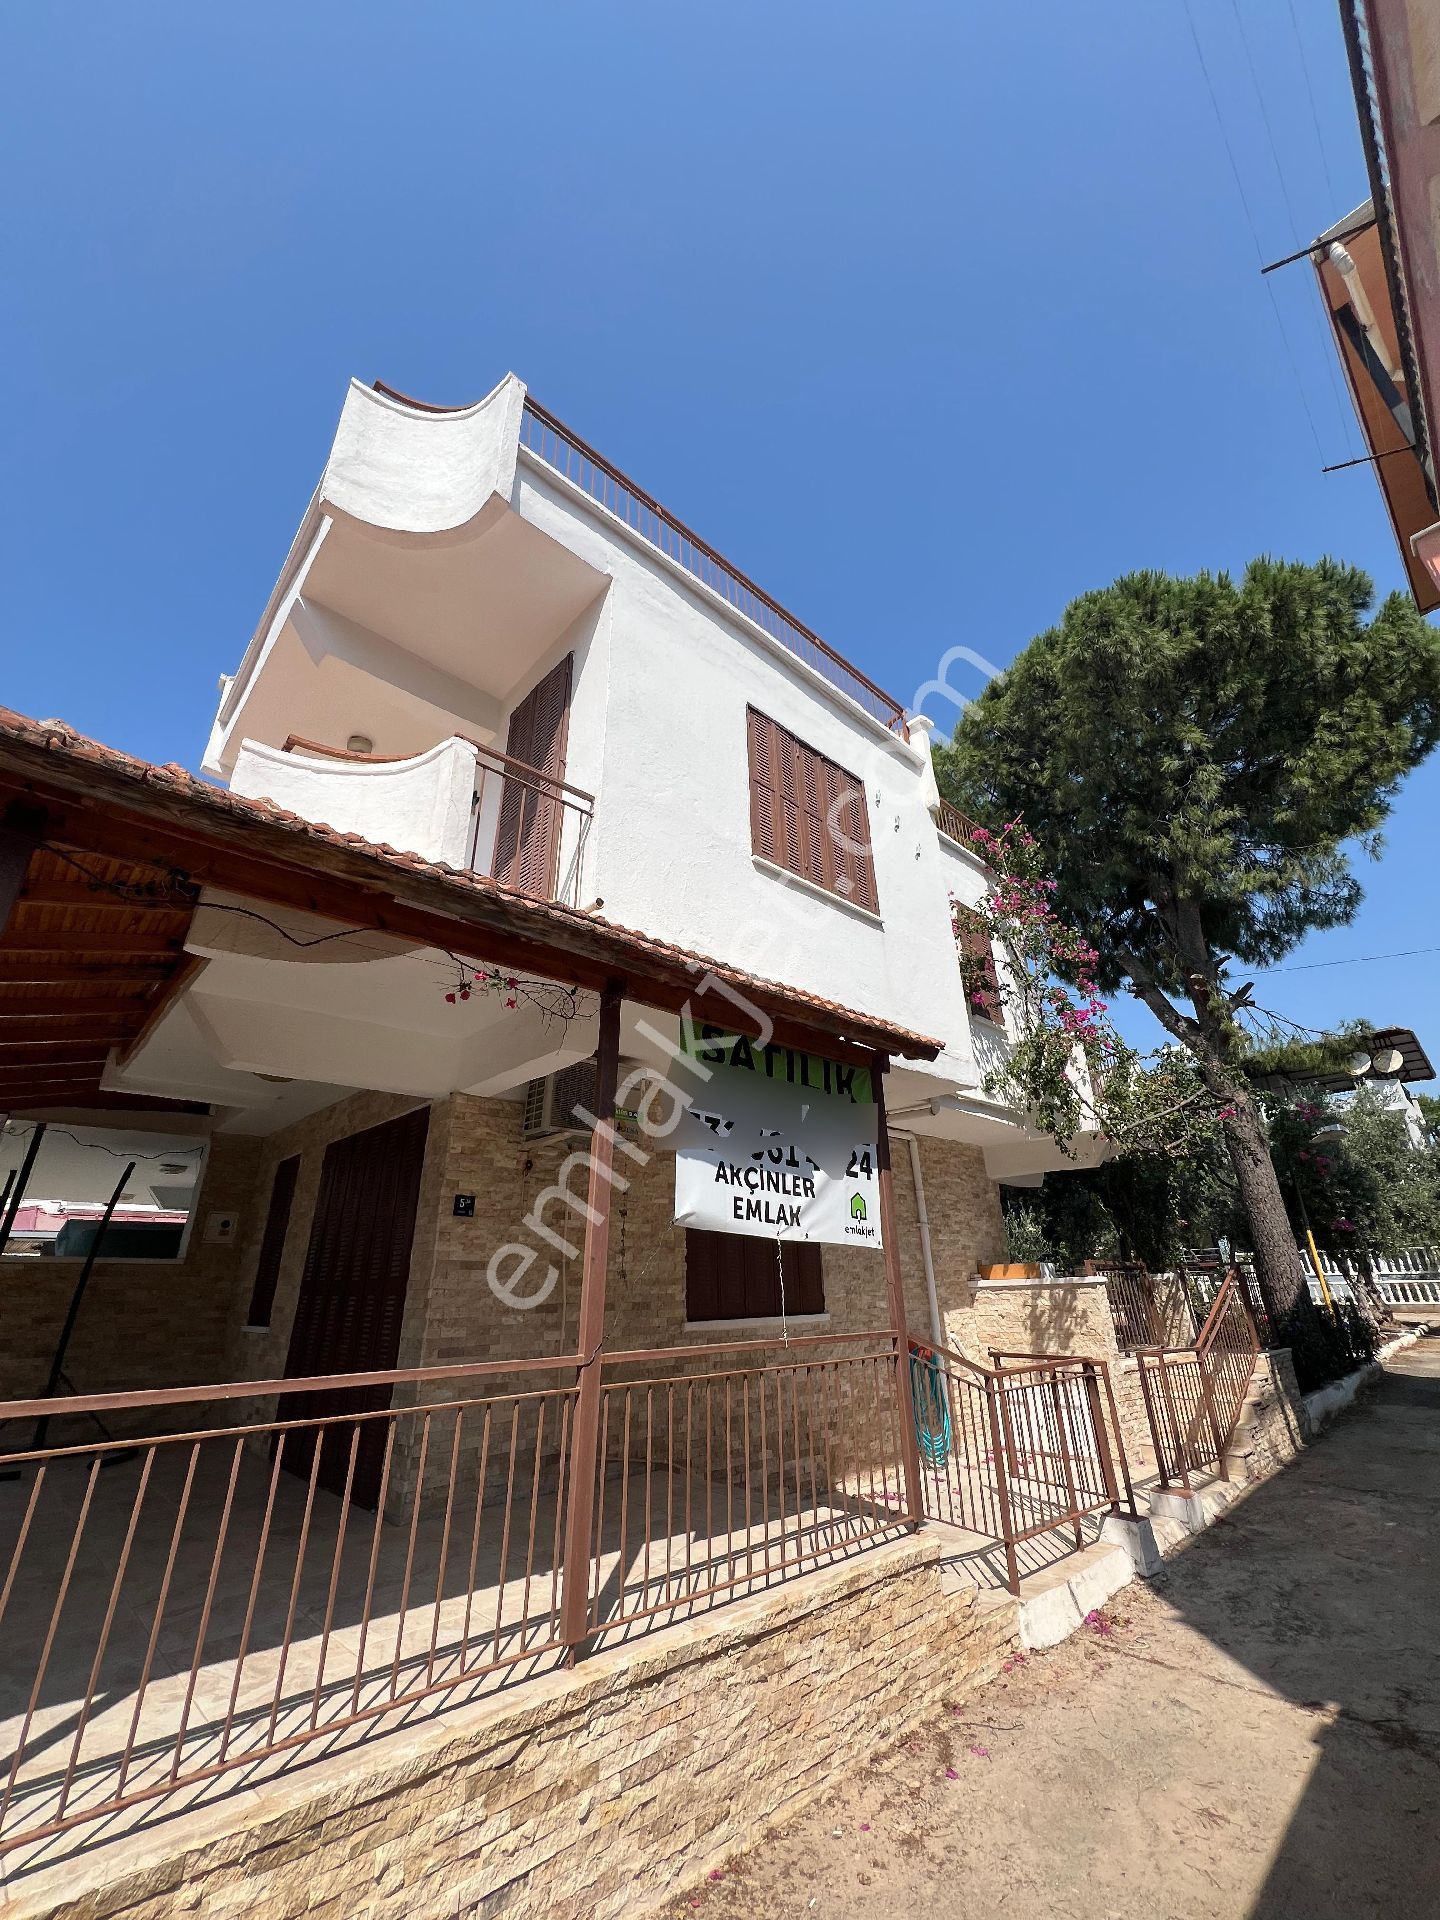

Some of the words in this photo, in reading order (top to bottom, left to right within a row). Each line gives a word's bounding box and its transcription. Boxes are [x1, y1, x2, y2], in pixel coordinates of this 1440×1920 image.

[702, 1024, 858, 1104] SATILIK
[715, 1160, 816, 1198] AKÇİNLER
[733, 1196, 802, 1227] EMLAK
[844, 1224, 875, 1239] emlakjet
